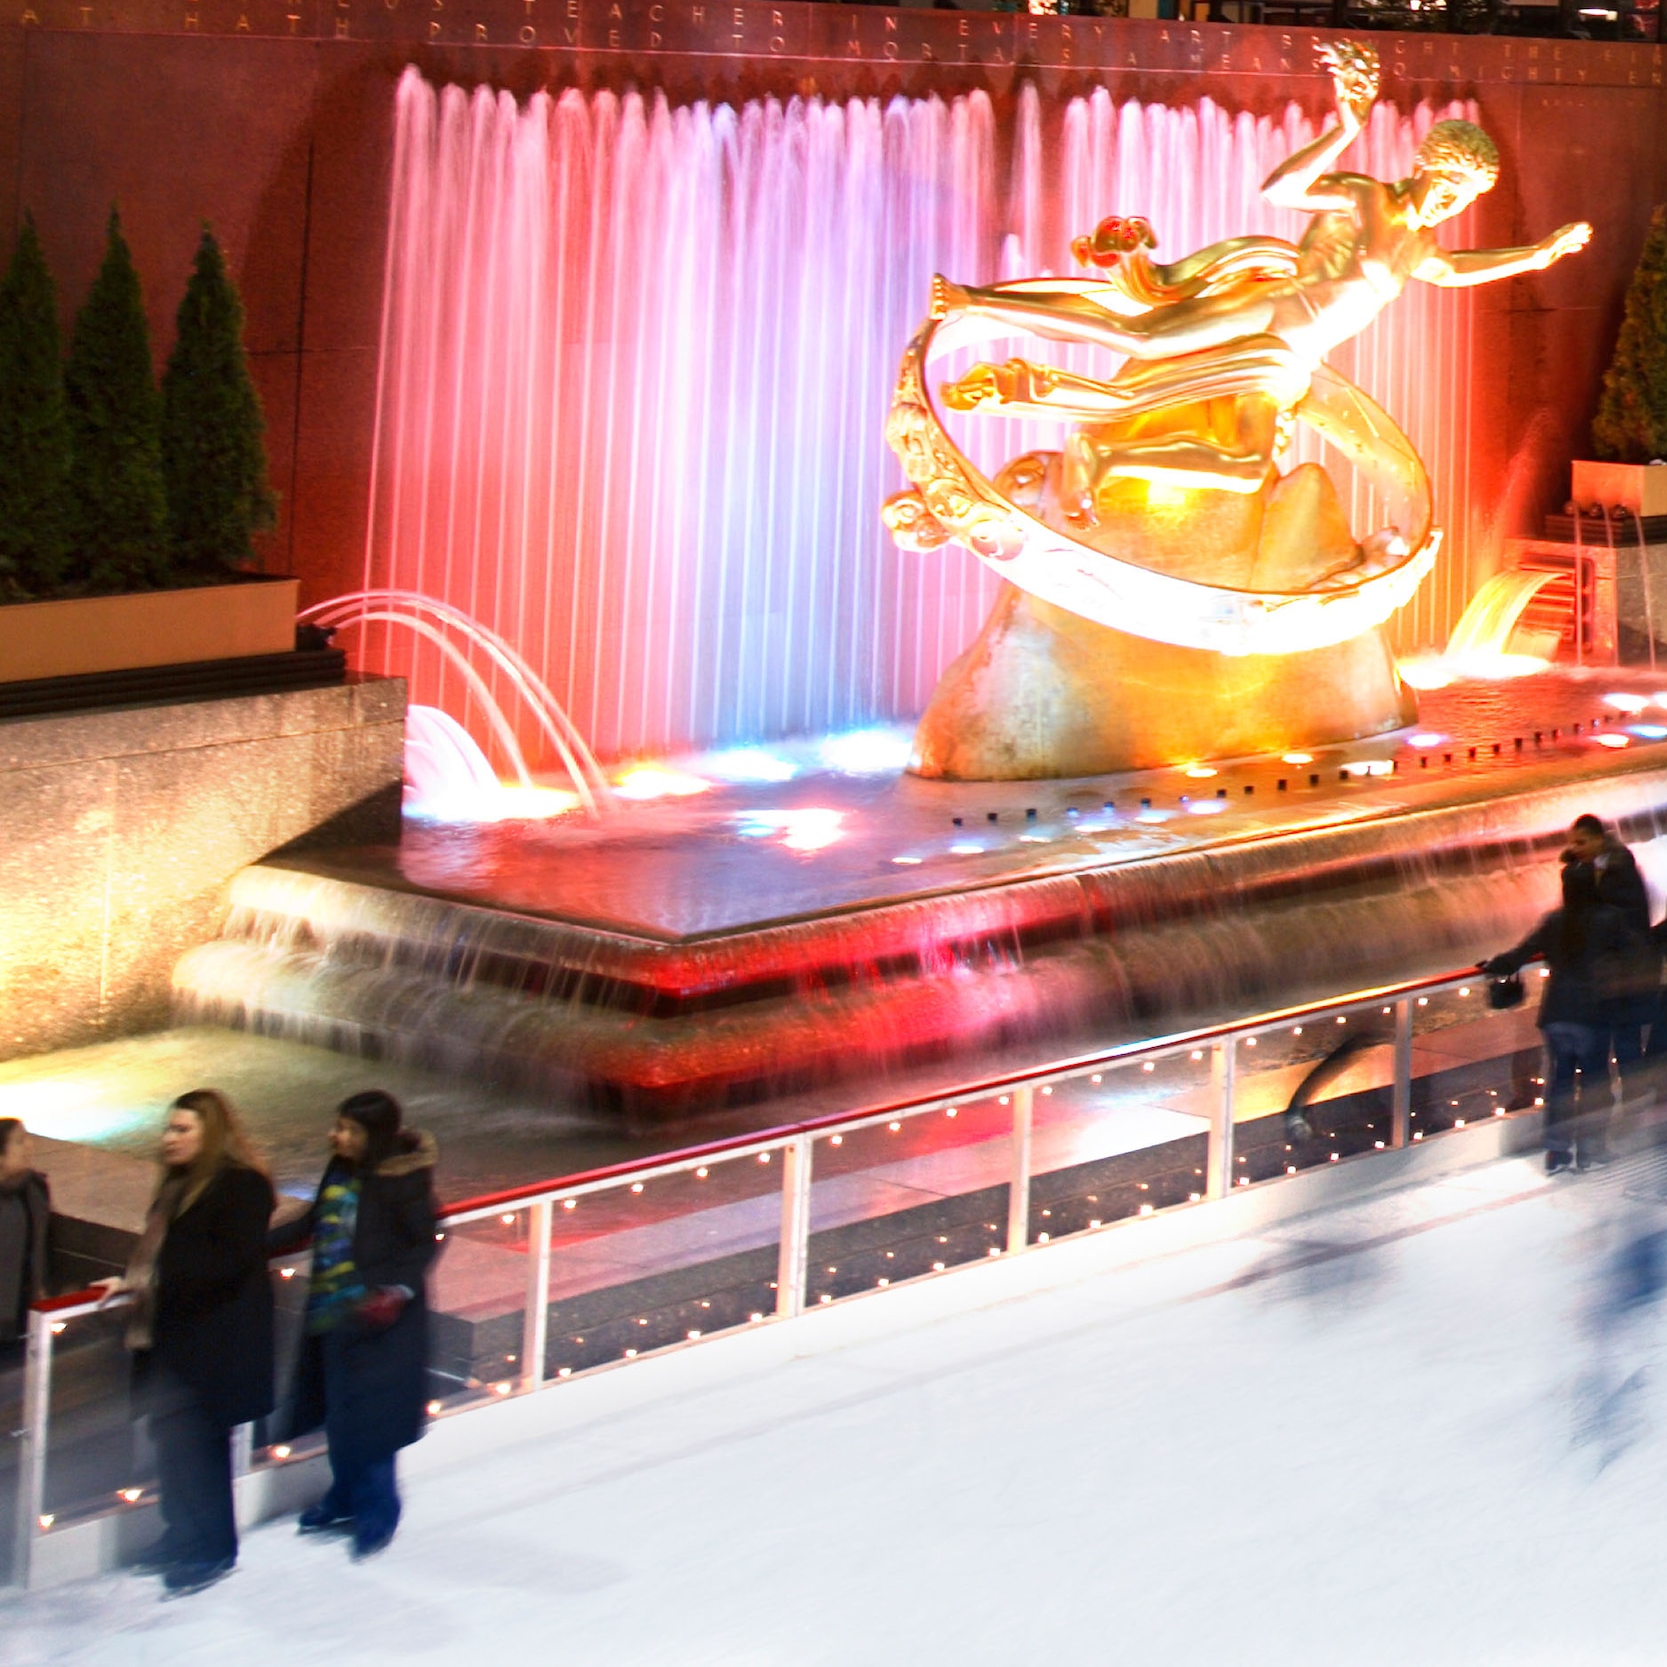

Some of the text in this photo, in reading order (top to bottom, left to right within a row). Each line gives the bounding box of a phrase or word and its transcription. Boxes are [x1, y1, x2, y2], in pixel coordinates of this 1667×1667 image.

[184, 11, 350, 39] HATH
[429, 21, 663, 48] PROVED
[732, 33, 786, 53] TO
[852, 13, 899, 33] IN
[957, 18, 1107, 40] EVERY
[1159, 28, 1233, 46] ART
[1503, 43, 1564, 61] THE
